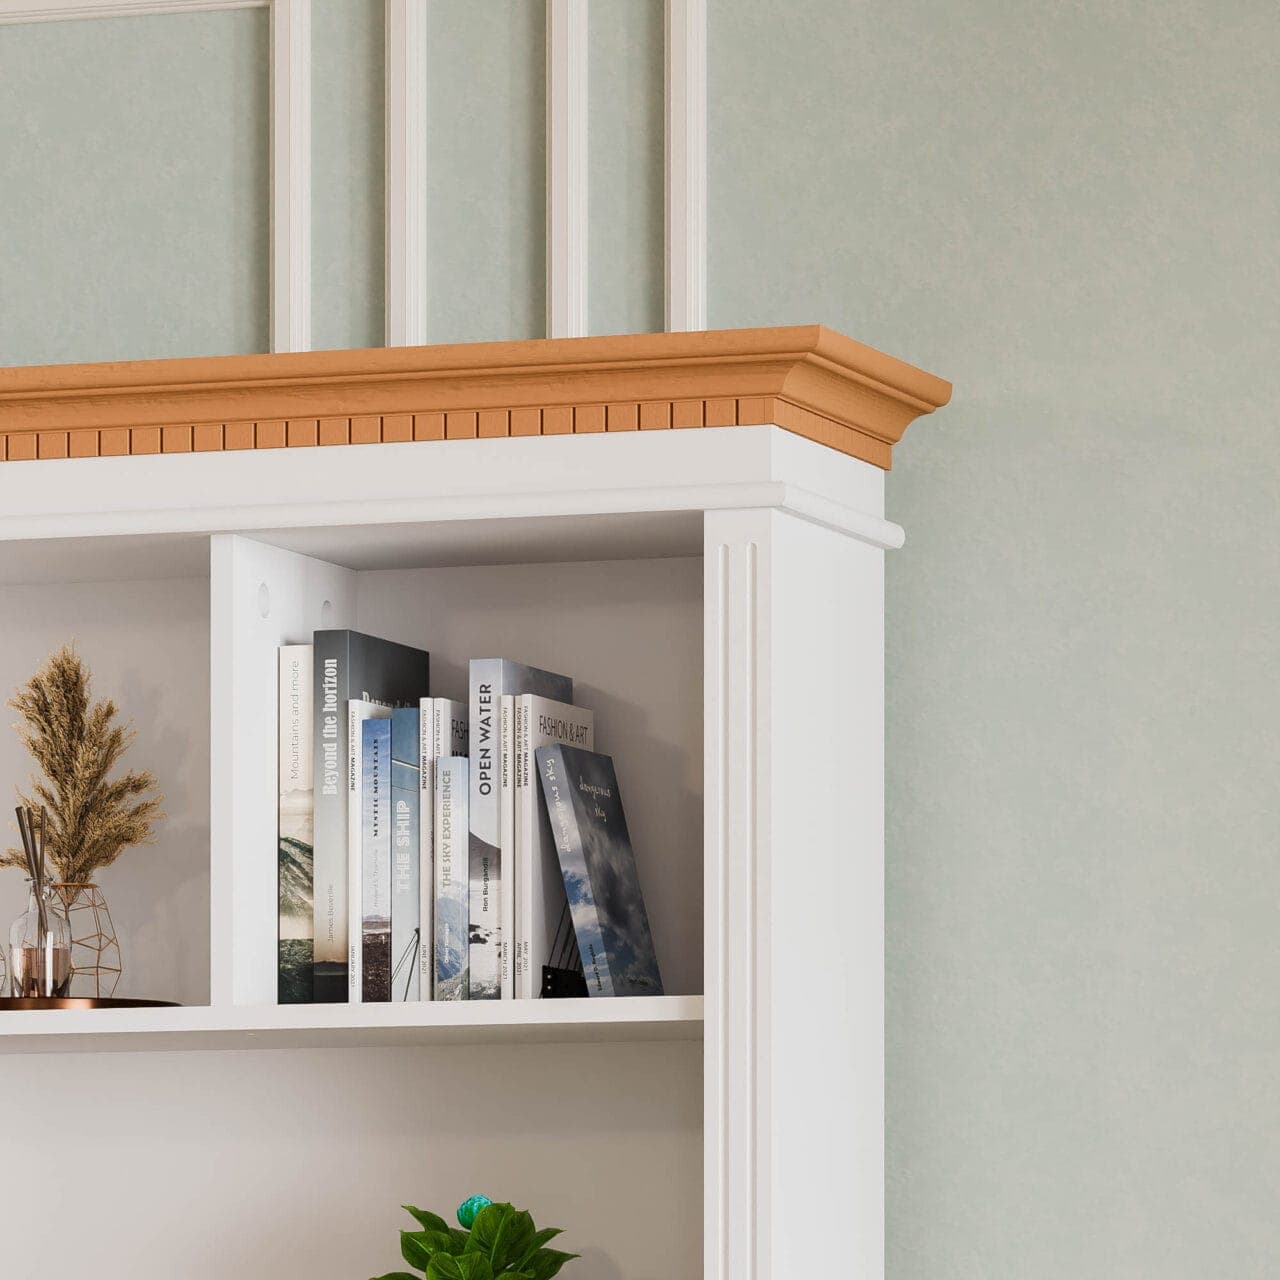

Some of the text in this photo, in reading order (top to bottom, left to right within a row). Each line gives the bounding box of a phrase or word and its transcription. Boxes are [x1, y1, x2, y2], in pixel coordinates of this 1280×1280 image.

[289, 660, 300, 779] Mountains and more
[322, 658, 338, 795] Beyond the horizon
[479, 684, 492, 796] OPEN WATER
[539, 715, 589, 744] FASHION & ART
[545, 758, 556, 781] sky
[397, 800, 410, 892] THE SHIP
[442, 770, 451, 888] THE SKY EXPERIENCE
